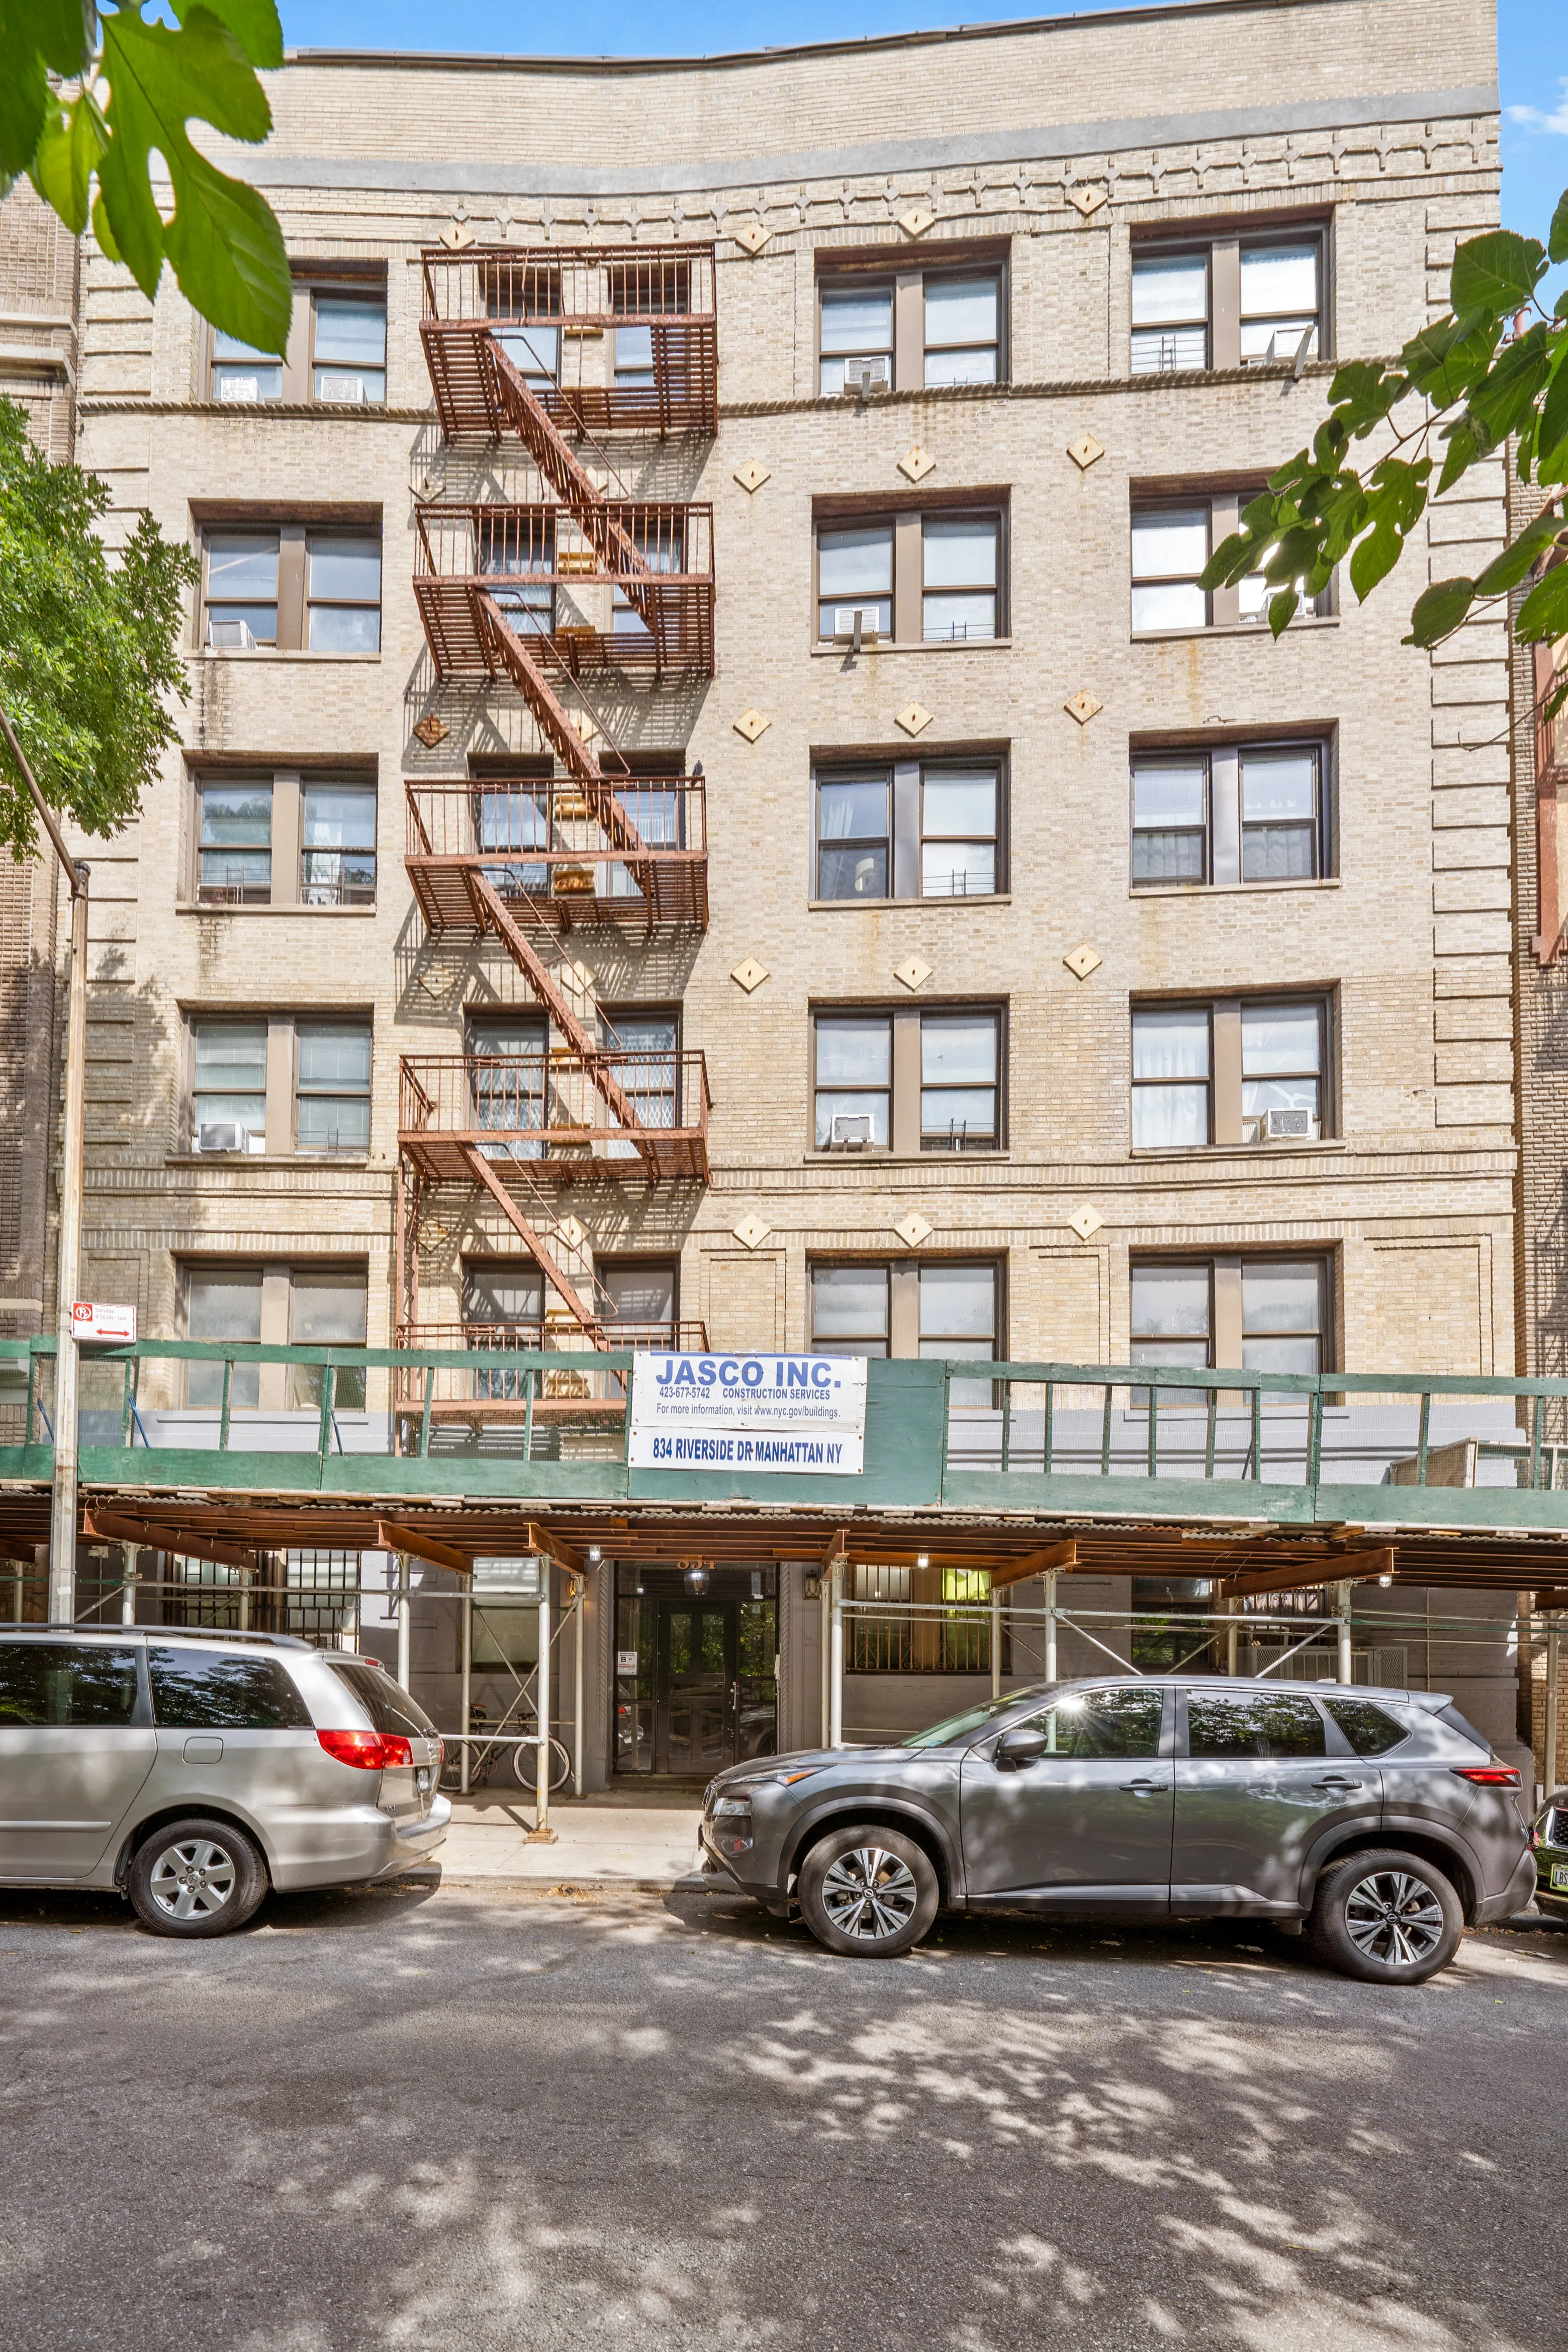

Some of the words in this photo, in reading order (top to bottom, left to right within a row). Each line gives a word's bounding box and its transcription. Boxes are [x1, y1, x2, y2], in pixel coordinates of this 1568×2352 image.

[656, 1360, 763, 1387] JASCO
[776, 1362, 841, 1388] INC.
[660, 1387, 709, 1398] 423-677-5742
[723, 1388, 787, 1399] CONSTRUCTION
[791, 1389, 830, 1399] SERVICES
[657, 1403, 669, 1413] For
[671, 1406, 689, 1414] more
[692, 1404, 734, 1416] information,
[737, 1405, 752, 1415] visit
[754, 1405, 840, 1419] www.nyc.gov/buildings.
[653, 1438, 672, 1459] 834
[676, 1438, 733, 1461] RIVERSIDE
[737, 1441, 752, 1461] DR
[756, 1441, 823, 1463] MANHATTAN
[827, 1444, 842, 1463] NY
